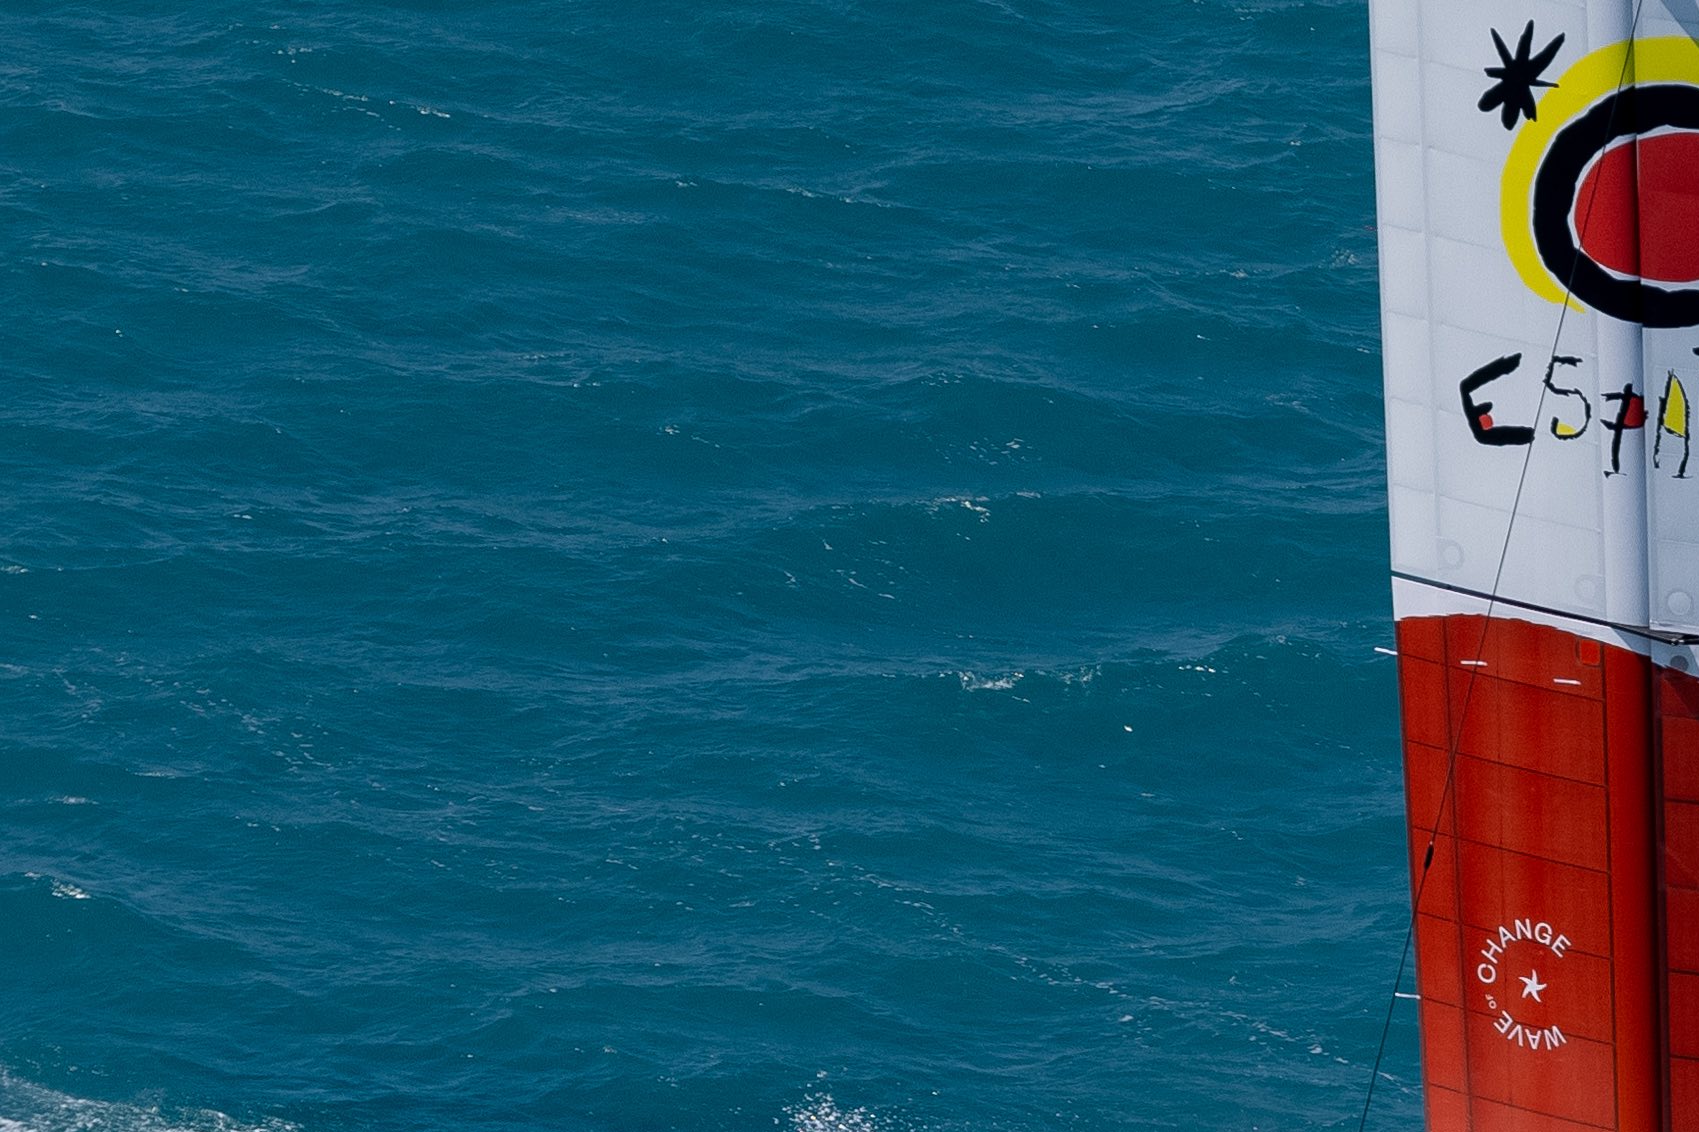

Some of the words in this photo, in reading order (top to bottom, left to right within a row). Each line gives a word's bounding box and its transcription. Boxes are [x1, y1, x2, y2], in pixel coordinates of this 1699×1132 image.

[1477, 918, 1572, 984] CHANGE
[1484, 993, 1497, 1009] OF
[1493, 1010, 1567, 1050] WAVE
